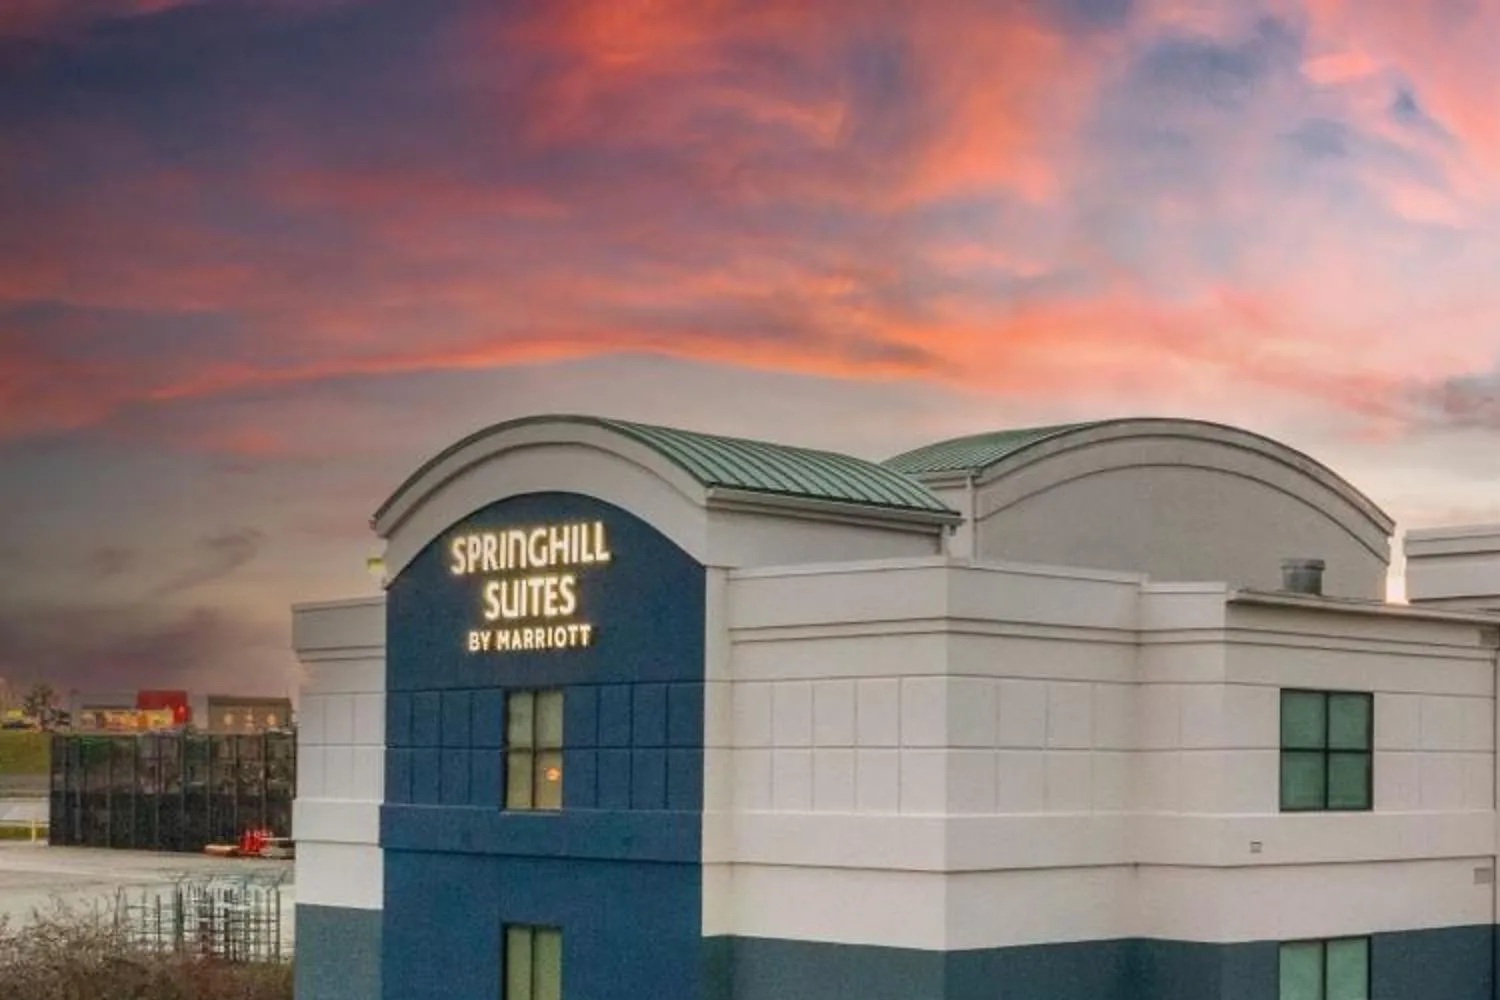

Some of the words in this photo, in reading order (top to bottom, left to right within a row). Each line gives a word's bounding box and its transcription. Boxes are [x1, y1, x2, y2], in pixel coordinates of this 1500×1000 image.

[484, 575, 577, 620] SUITES
[468, 629, 491, 651] BY
[496, 624, 592, 650] MARRIOTT
